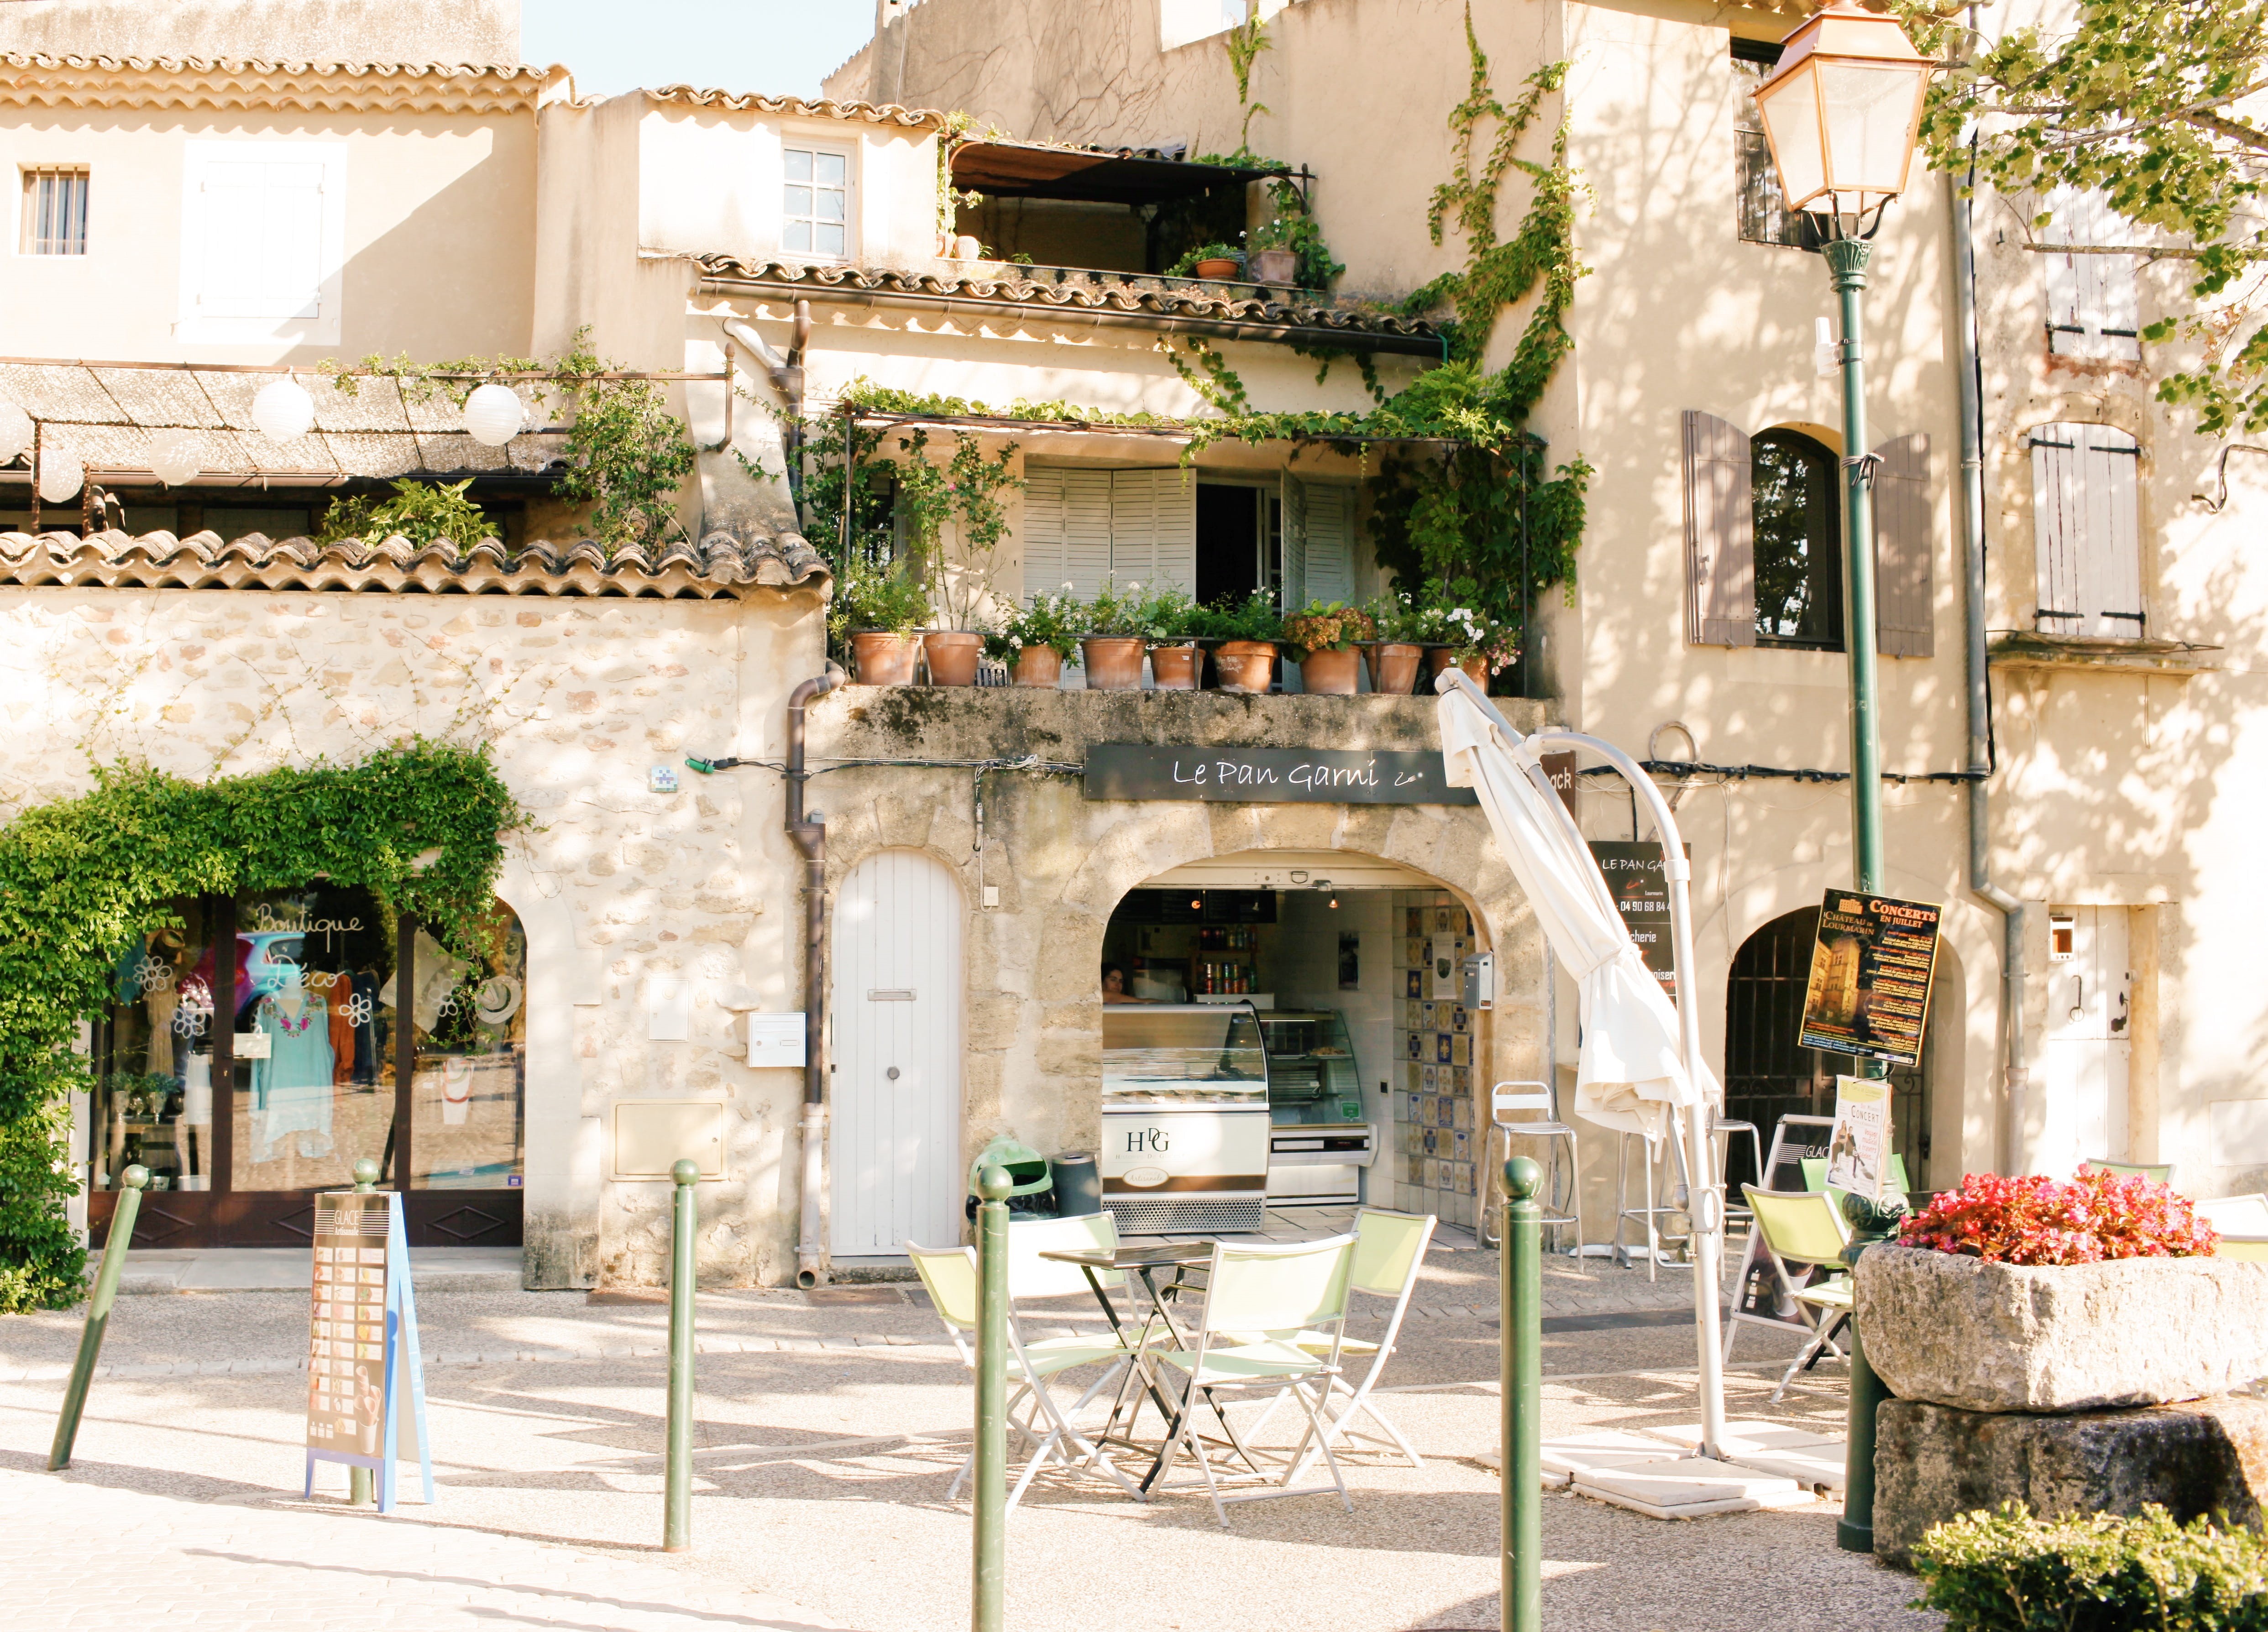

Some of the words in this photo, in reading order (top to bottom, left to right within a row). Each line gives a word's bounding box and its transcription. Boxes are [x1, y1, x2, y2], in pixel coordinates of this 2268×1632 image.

[1174, 761, 1206, 785] Le
[1216, 761, 1278, 785] Pan
[1289, 759, 1378, 791] Garni
[1550, 767, 1571, 789] ack
[1602, 859, 1617, 869] LE
[1620, 859, 1644, 870] PAN
[1647, 860, 1664, 872] GA
[1621, 901, 1631, 911] 04
[1632, 901, 1643, 911] 90
[1644, 901, 1654, 911] 68
[1656, 901, 1666, 911] 84
[1667, 902, 1671, 910] 4
[1870, 900, 1937, 922] CONCERTS
[1826, 911, 1866, 926] CHÂTEAU
[1892, 917, 1923, 928] JUILLET
[252, 903, 364, 953] Boutique
[1823, 919, 1875, 935] LOURMARIN
[1629, 929, 1656, 942] cherie
[267, 954, 346, 988] Déco
[1851, 1105, 1879, 1124] CONCERT
[1806, 1146, 1829, 1158] GLAC
[335, 1210, 359, 1225] GLACE
[335, 1226, 359, 1236] Artisanale
